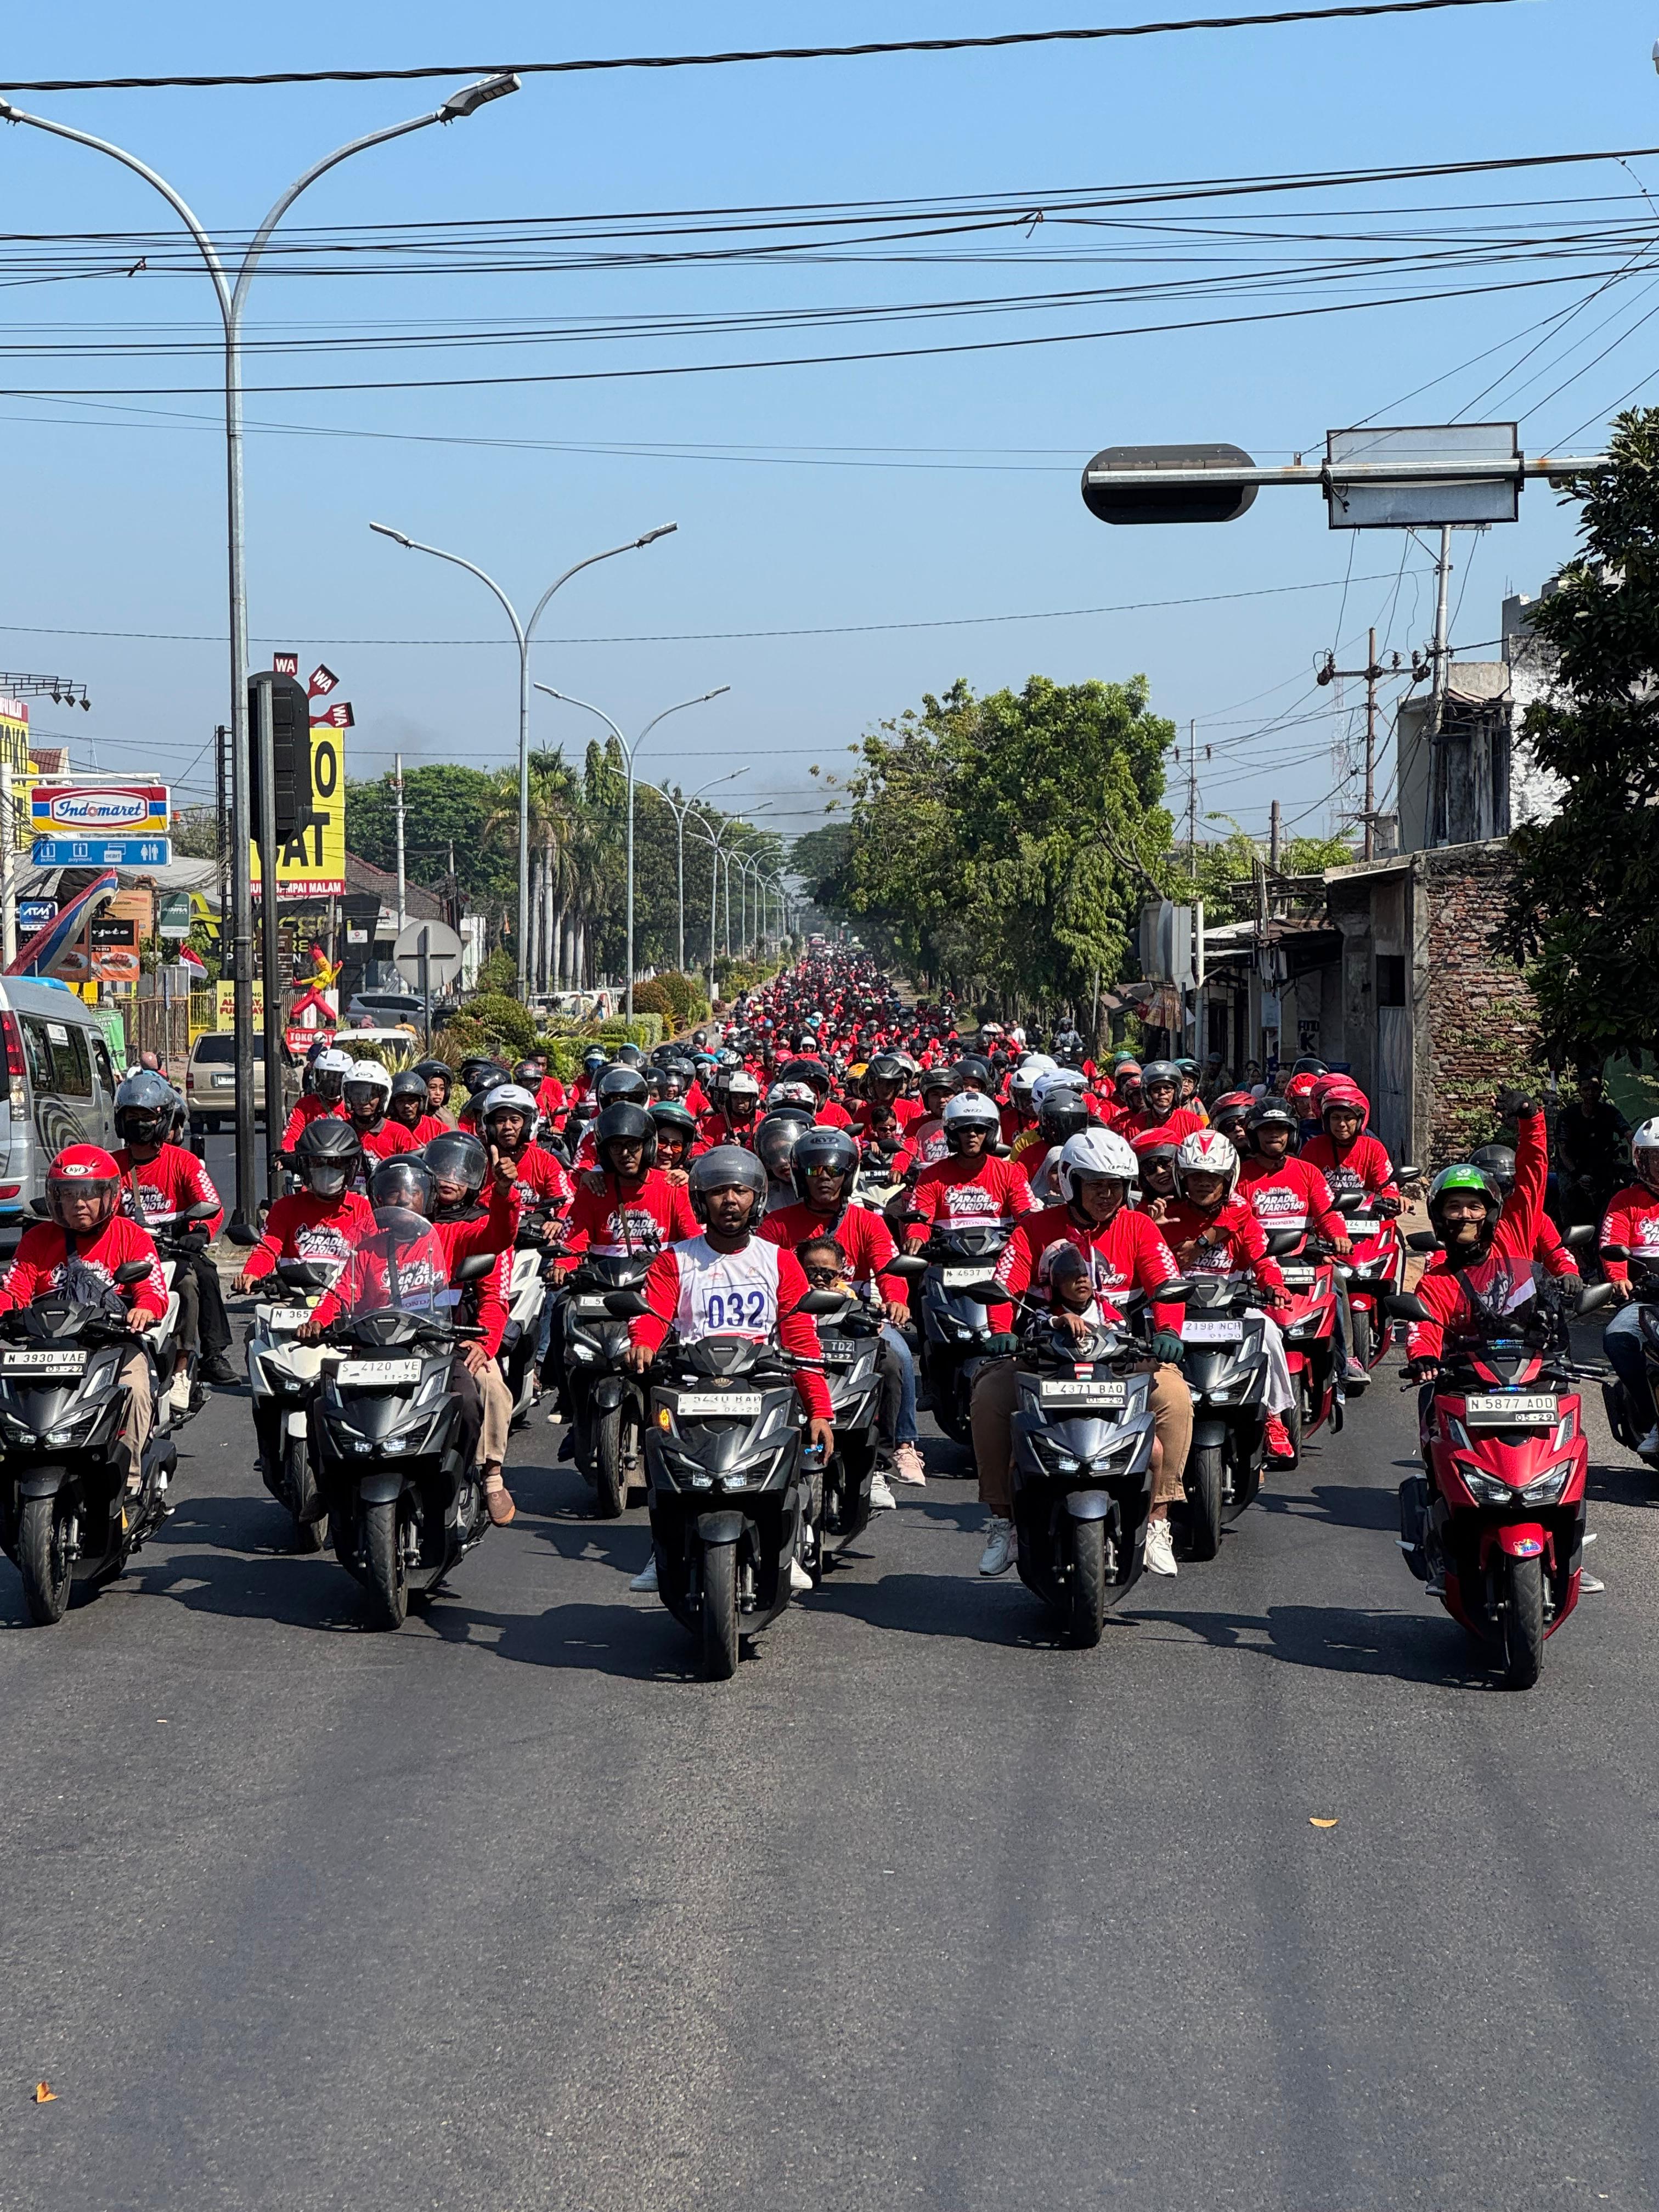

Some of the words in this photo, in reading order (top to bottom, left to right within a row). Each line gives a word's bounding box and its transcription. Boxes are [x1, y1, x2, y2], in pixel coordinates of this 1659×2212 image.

[276, 658, 295, 673] WA
[313, 670, 332, 692] WA
[332, 705, 348, 727] WA
[56, 800, 142, 817] Indomaret
[309, 882, 341, 893] MALAM
[290, 1032, 313, 1042] TOKO
[947, 1192, 991, 1203] PARADE
[1255, 1194, 1296, 1205] PARADE
[950, 1201, 999, 1215] VARIO160
[1259, 1201, 1305, 1215] VARIO160
[708, 1290, 765, 1329] 032
[831, 1342, 853, 1352] TDZ
[8, 1354, 15, 1363] N
[23, 1353, 54, 1363] 3930
[62, 1353, 85, 1362] VAE
[342, 1363, 348, 1372] S
[361, 1362, 392, 1372] 4120
[404, 1361, 419, 1370] VE
[1046, 1384, 1052, 1393] L
[1060, 1384, 1091, 1394] 4371
[1471, 1400, 1479, 1409] N
[1486, 1398, 1520, 1409] 5877
